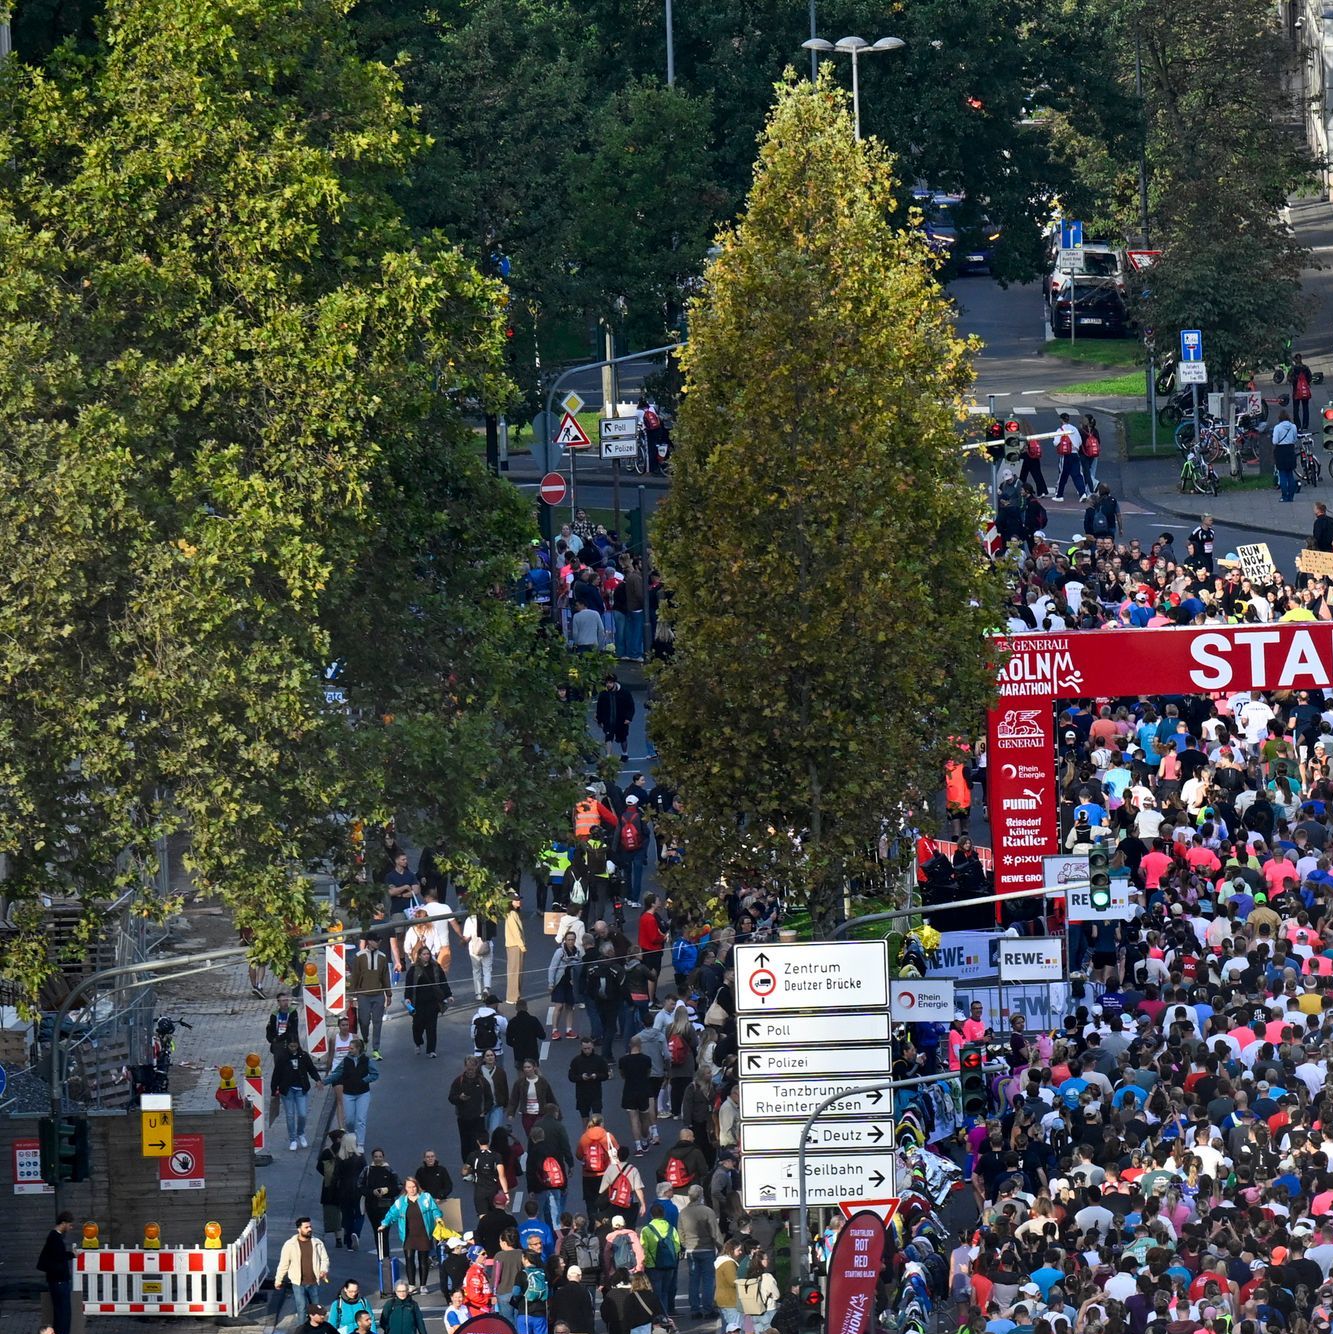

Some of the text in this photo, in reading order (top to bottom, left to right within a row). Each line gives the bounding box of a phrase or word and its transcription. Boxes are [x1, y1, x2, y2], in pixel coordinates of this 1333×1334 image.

[614, 424, 626, 432] Poll
[1239, 545, 1260, 556] RUN
[1243, 554, 1265, 566] NOW
[1244, 564, 1272, 577] PARTY
[1012, 639, 1069, 651] GENERALI
[998, 738, 1045, 749] GENERALI
[1018, 764, 1039, 772] Rhein
[1018, 771, 1045, 779] Energie
[1002, 798, 1037, 810] PUMA
[1006, 817, 1041, 827] Reissdorf
[1009, 827, 1040, 836] Kölner
[1002, 835, 1048, 847] Radler
[1001, 874, 1024, 883] REWE
[1004, 952, 1044, 965] REWE
[784, 962, 841, 975] Zentrum
[784, 977, 862, 992] Deutzer Brücke
[917, 993, 941, 1001] Rhein
[917, 1000, 949, 1010] Energie
[767, 1025, 791, 1036] Poll
[768, 1057, 808, 1069] Polizei
[823, 1129, 862, 1142] Deutz
[804, 1163, 863, 1176] Seilbahn
[854, 1239, 870, 1251] ROT
[853, 1255, 868, 1268] RED
